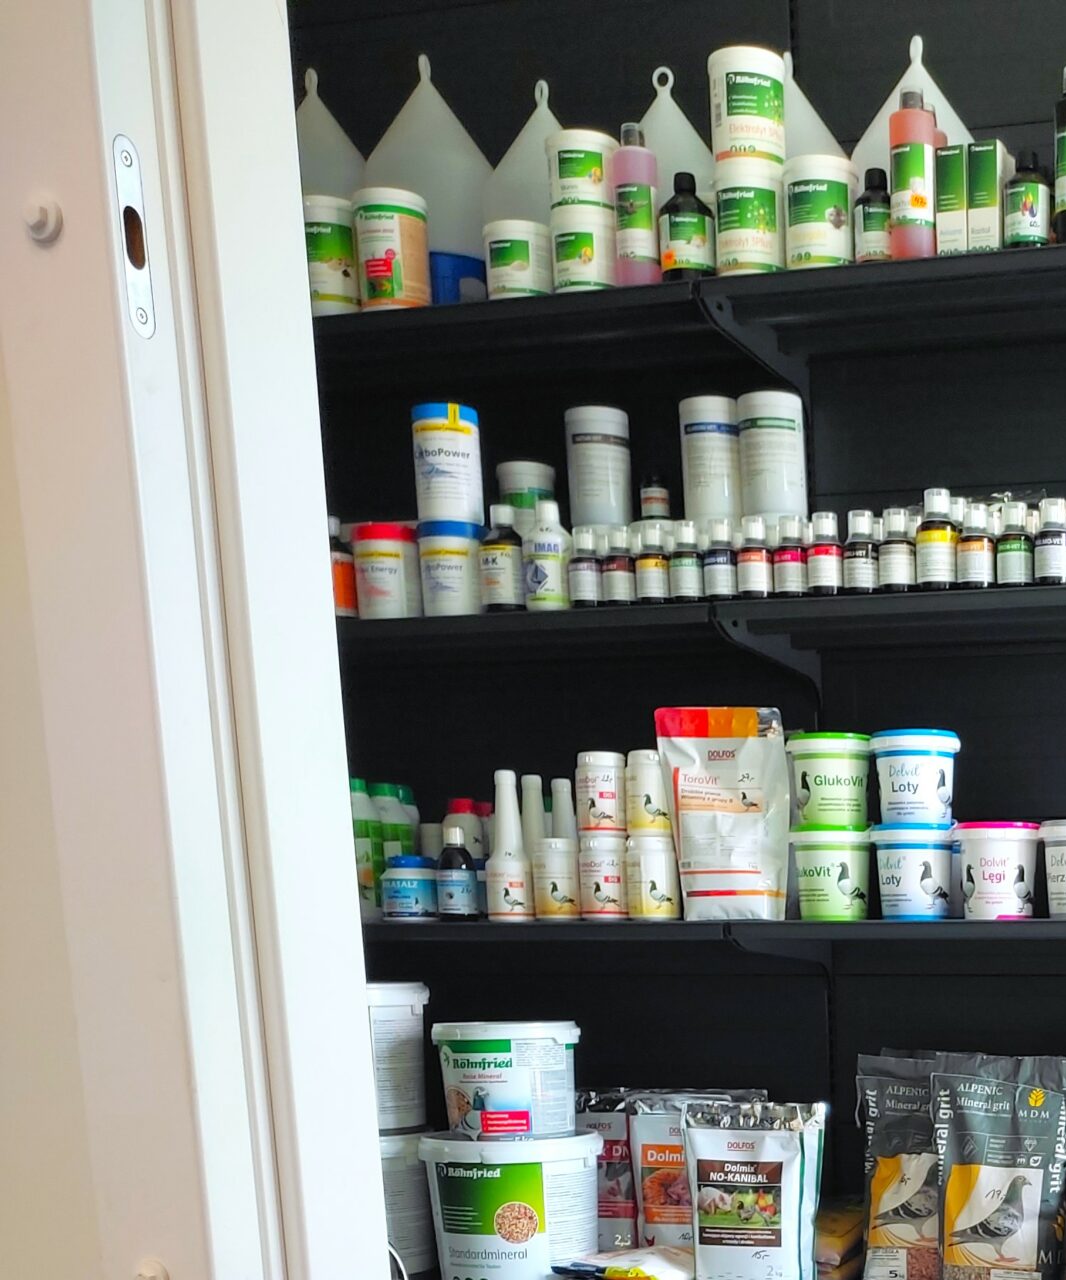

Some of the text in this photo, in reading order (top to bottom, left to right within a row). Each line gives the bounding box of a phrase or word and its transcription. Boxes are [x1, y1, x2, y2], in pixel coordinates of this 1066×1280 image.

[682, 773, 718, 786] ToroVit
[813, 775, 864, 788] GlukoVit
[891, 781, 920, 795] Loty
[979, 857, 1007, 868] Dolvit
[881, 873, 902, 888] Loty
[982, 870, 1006, 884] Lęgi
[452, 1056, 513, 1071] Röhnfried
[957, 1082, 1004, 1096] ALPENIC
[885, 1100, 920, 1111] Mineral
[937, 1088, 954, 1119] grit
[956, 1097, 1011, 1113] Mineral grit
[726, 1141, 756, 1151] DOLFOS
[646, 1150, 685, 1163] Dolmi
[447, 1167, 502, 1180] Röhnfried
[724, 1162, 755, 1174] Dolmix
[709, 1171, 769, 1184] NO-KANIBAL
[449, 1246, 529, 1261] Standardmineral
